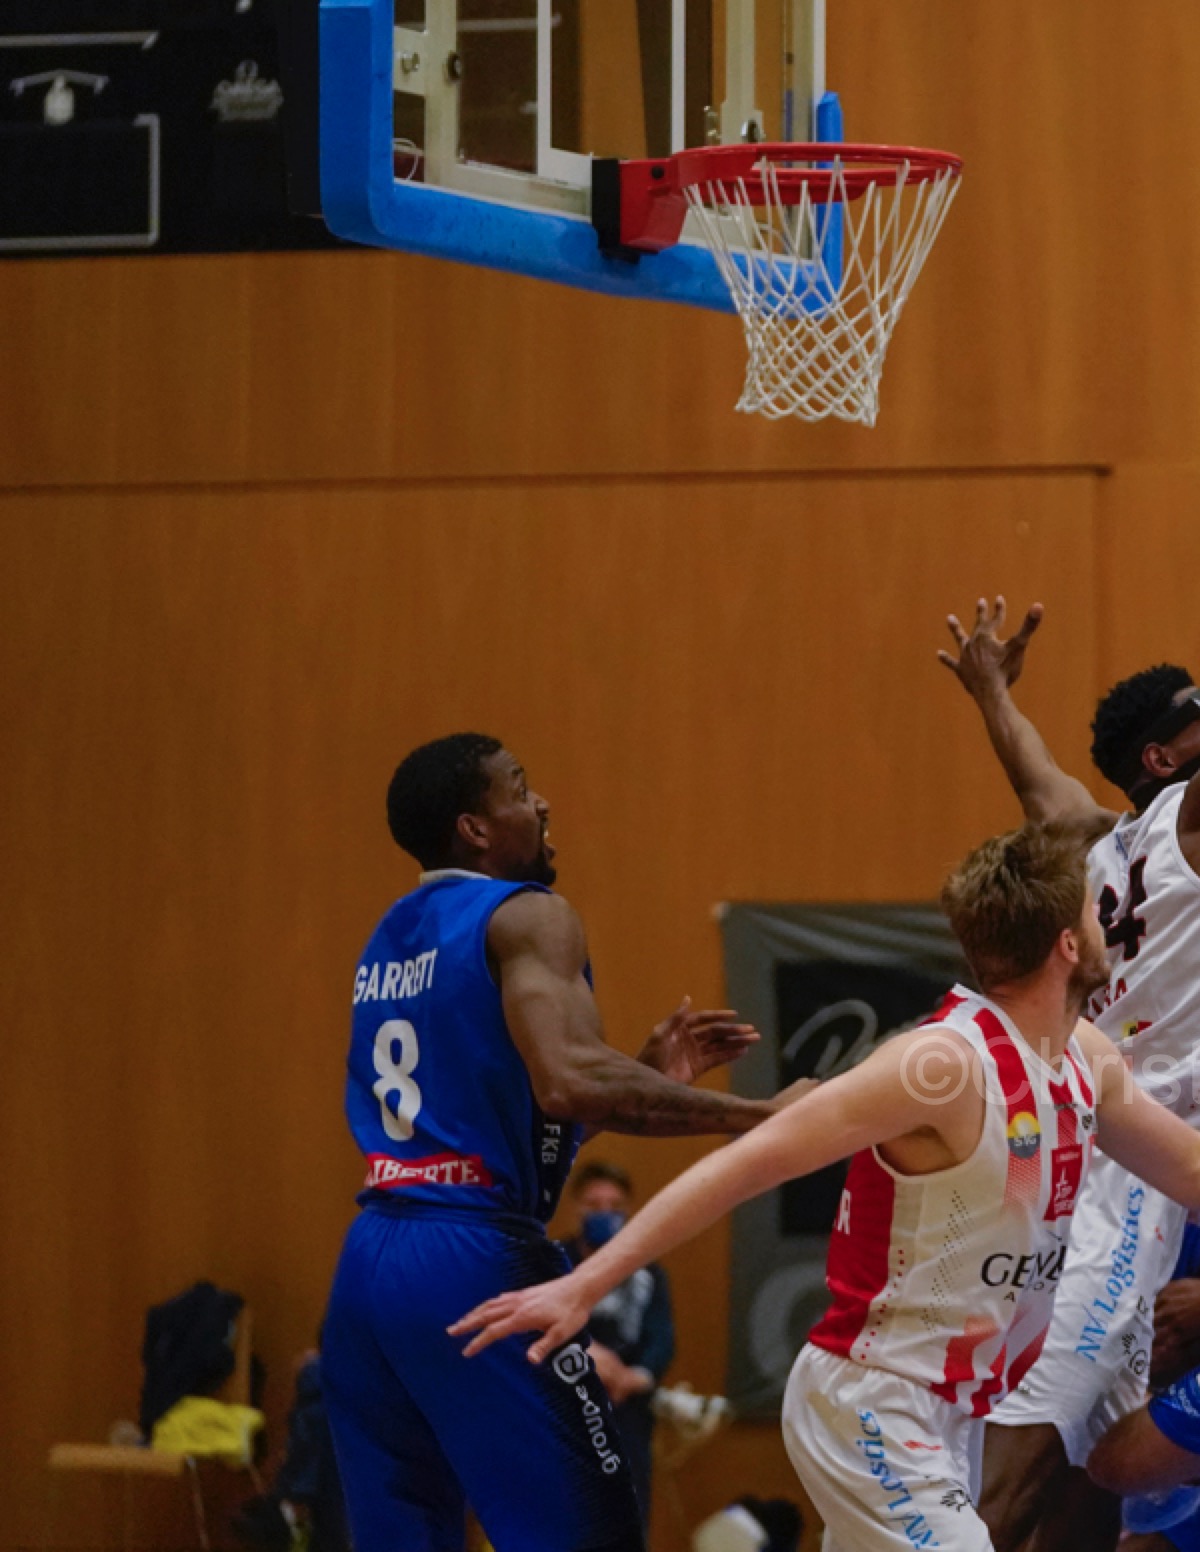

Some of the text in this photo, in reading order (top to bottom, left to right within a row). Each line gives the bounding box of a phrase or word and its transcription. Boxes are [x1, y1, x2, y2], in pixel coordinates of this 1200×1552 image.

[353, 947, 438, 1005] GARRETT
[372, 1018, 423, 1142] 8
[540, 1123, 561, 1165] FKB
[1094, 1185, 1144, 1315] Logistics
